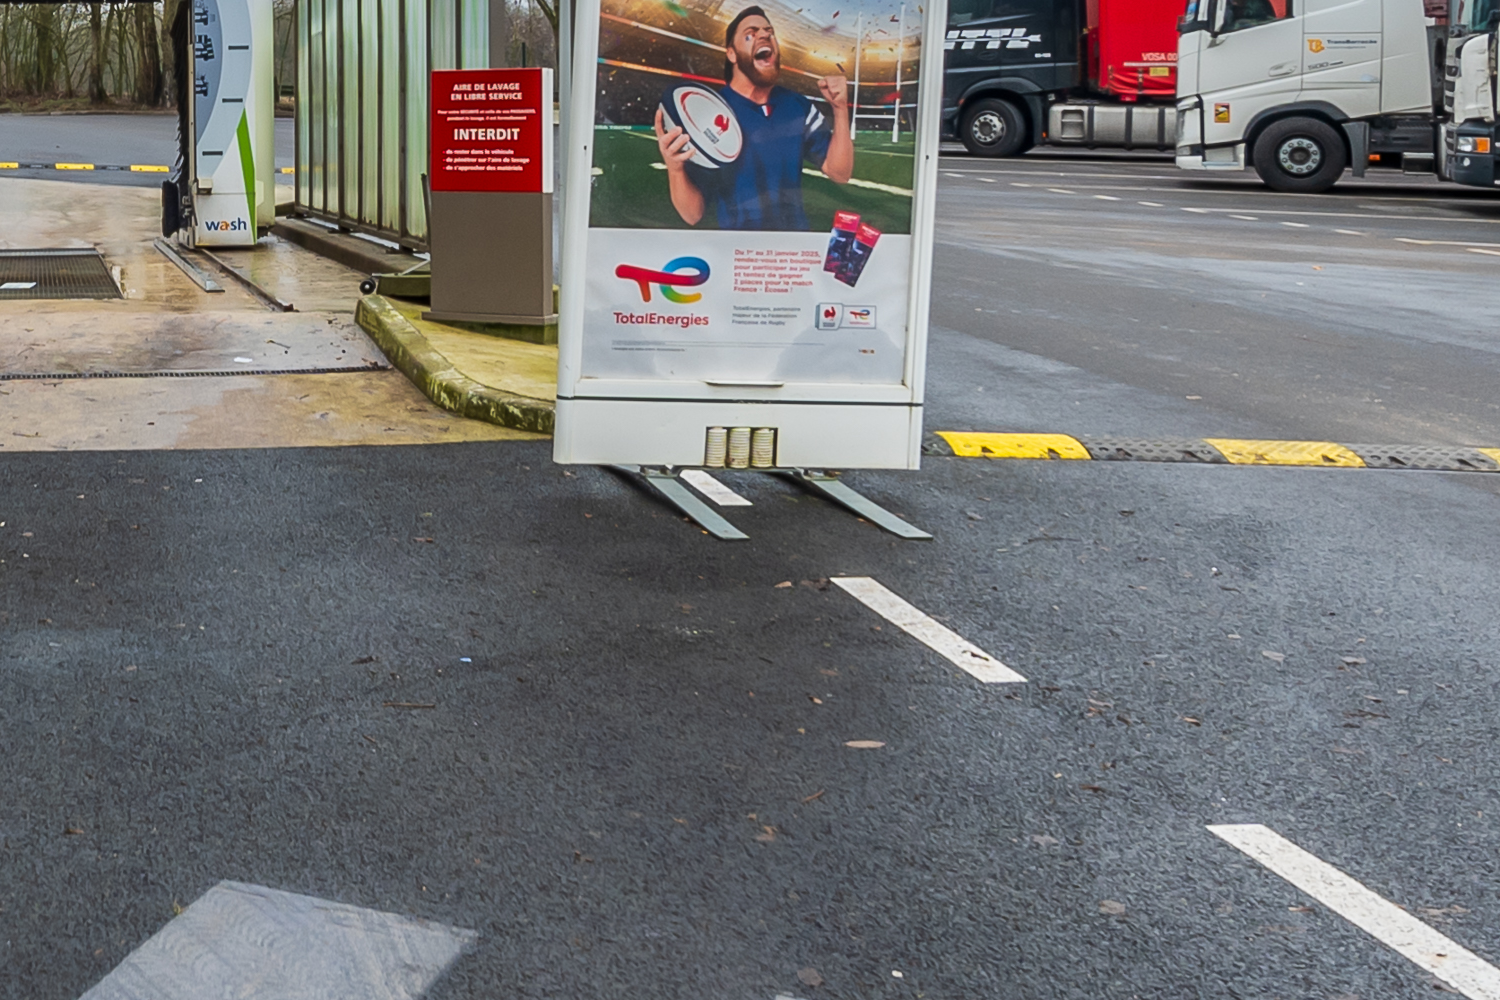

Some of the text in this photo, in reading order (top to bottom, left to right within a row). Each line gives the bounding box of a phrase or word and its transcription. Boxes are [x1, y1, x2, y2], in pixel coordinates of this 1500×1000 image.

[453, 83, 472, 91] AIRE
[474, 83, 485, 91] DE
[451, 93, 462, 101] EN
[489, 92, 522, 100] SERVICE
[453, 128, 520, 140] INTERDIT
[205, 217, 247, 231] wash
[613, 312, 709, 328] TotalEnergies
